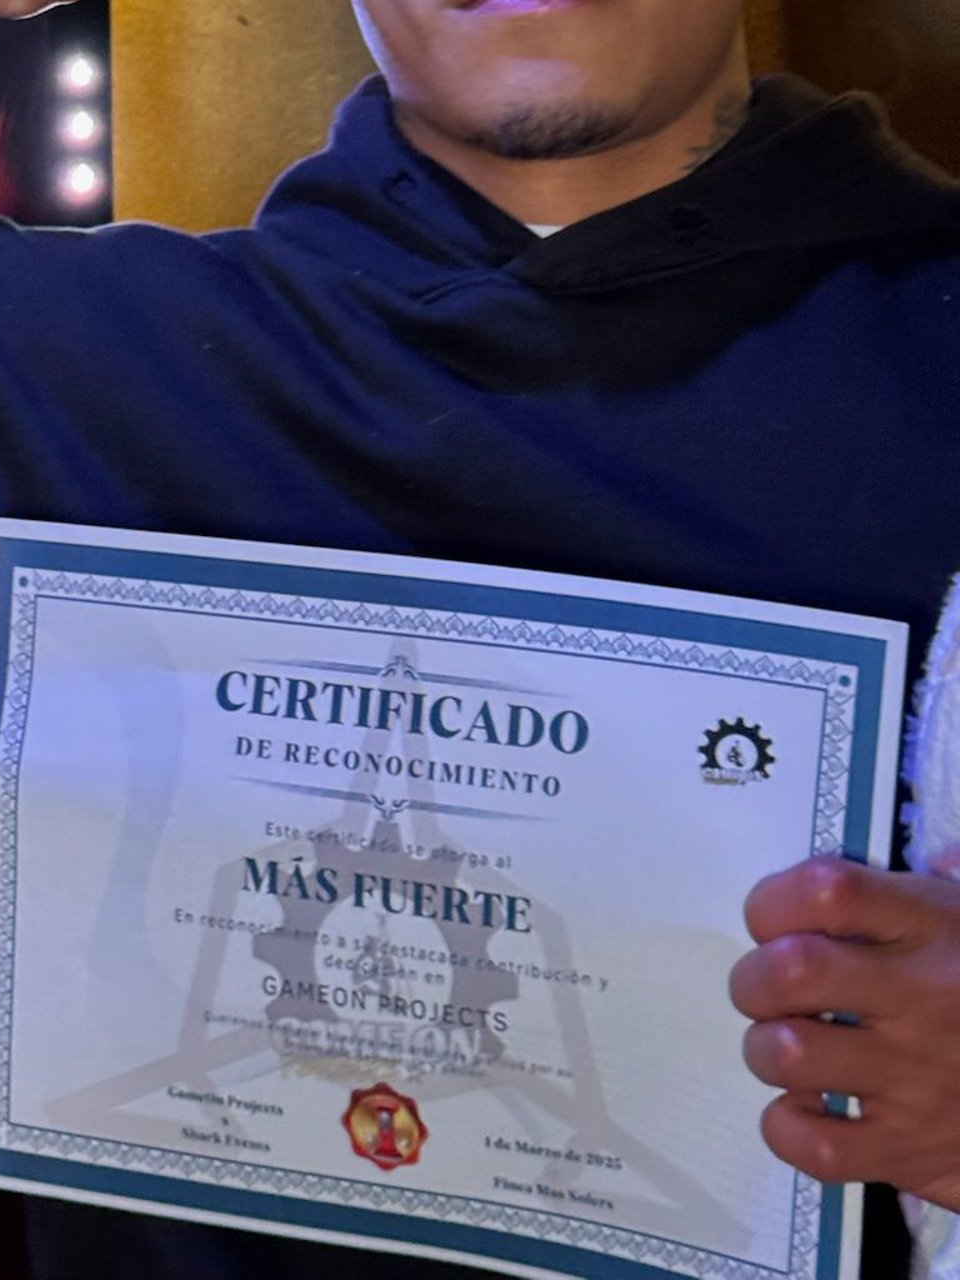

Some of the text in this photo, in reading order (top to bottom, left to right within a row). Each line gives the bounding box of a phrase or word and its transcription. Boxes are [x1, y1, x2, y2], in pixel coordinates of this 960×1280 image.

[215, 670, 589, 755] CERTIFICADO
[234, 736, 561, 797] DE RECONOCIMIENTO
[265, 822, 512, 869] Este certificado se otorga al
[240, 855, 532, 933] MÁS FUERTE
[174, 907, 194, 923] En
[200, 914, 330, 948] reconocimiento
[336, 936, 346, 949] a
[382, 941, 468, 967] destacada
[477, 957, 592, 986] contribución
[599, 977, 609, 992] y
[424, 971, 445, 985] en
[262, 974, 509, 1033] GAMEON PROJECTS
[227, 1094, 285, 1117] Projects
[493, 1137, 511, 1152] de
[515, 1139, 562, 1161] Marzo
[564, 1149, 582, 1163] de
[585, 1151, 623, 1172] 2025
